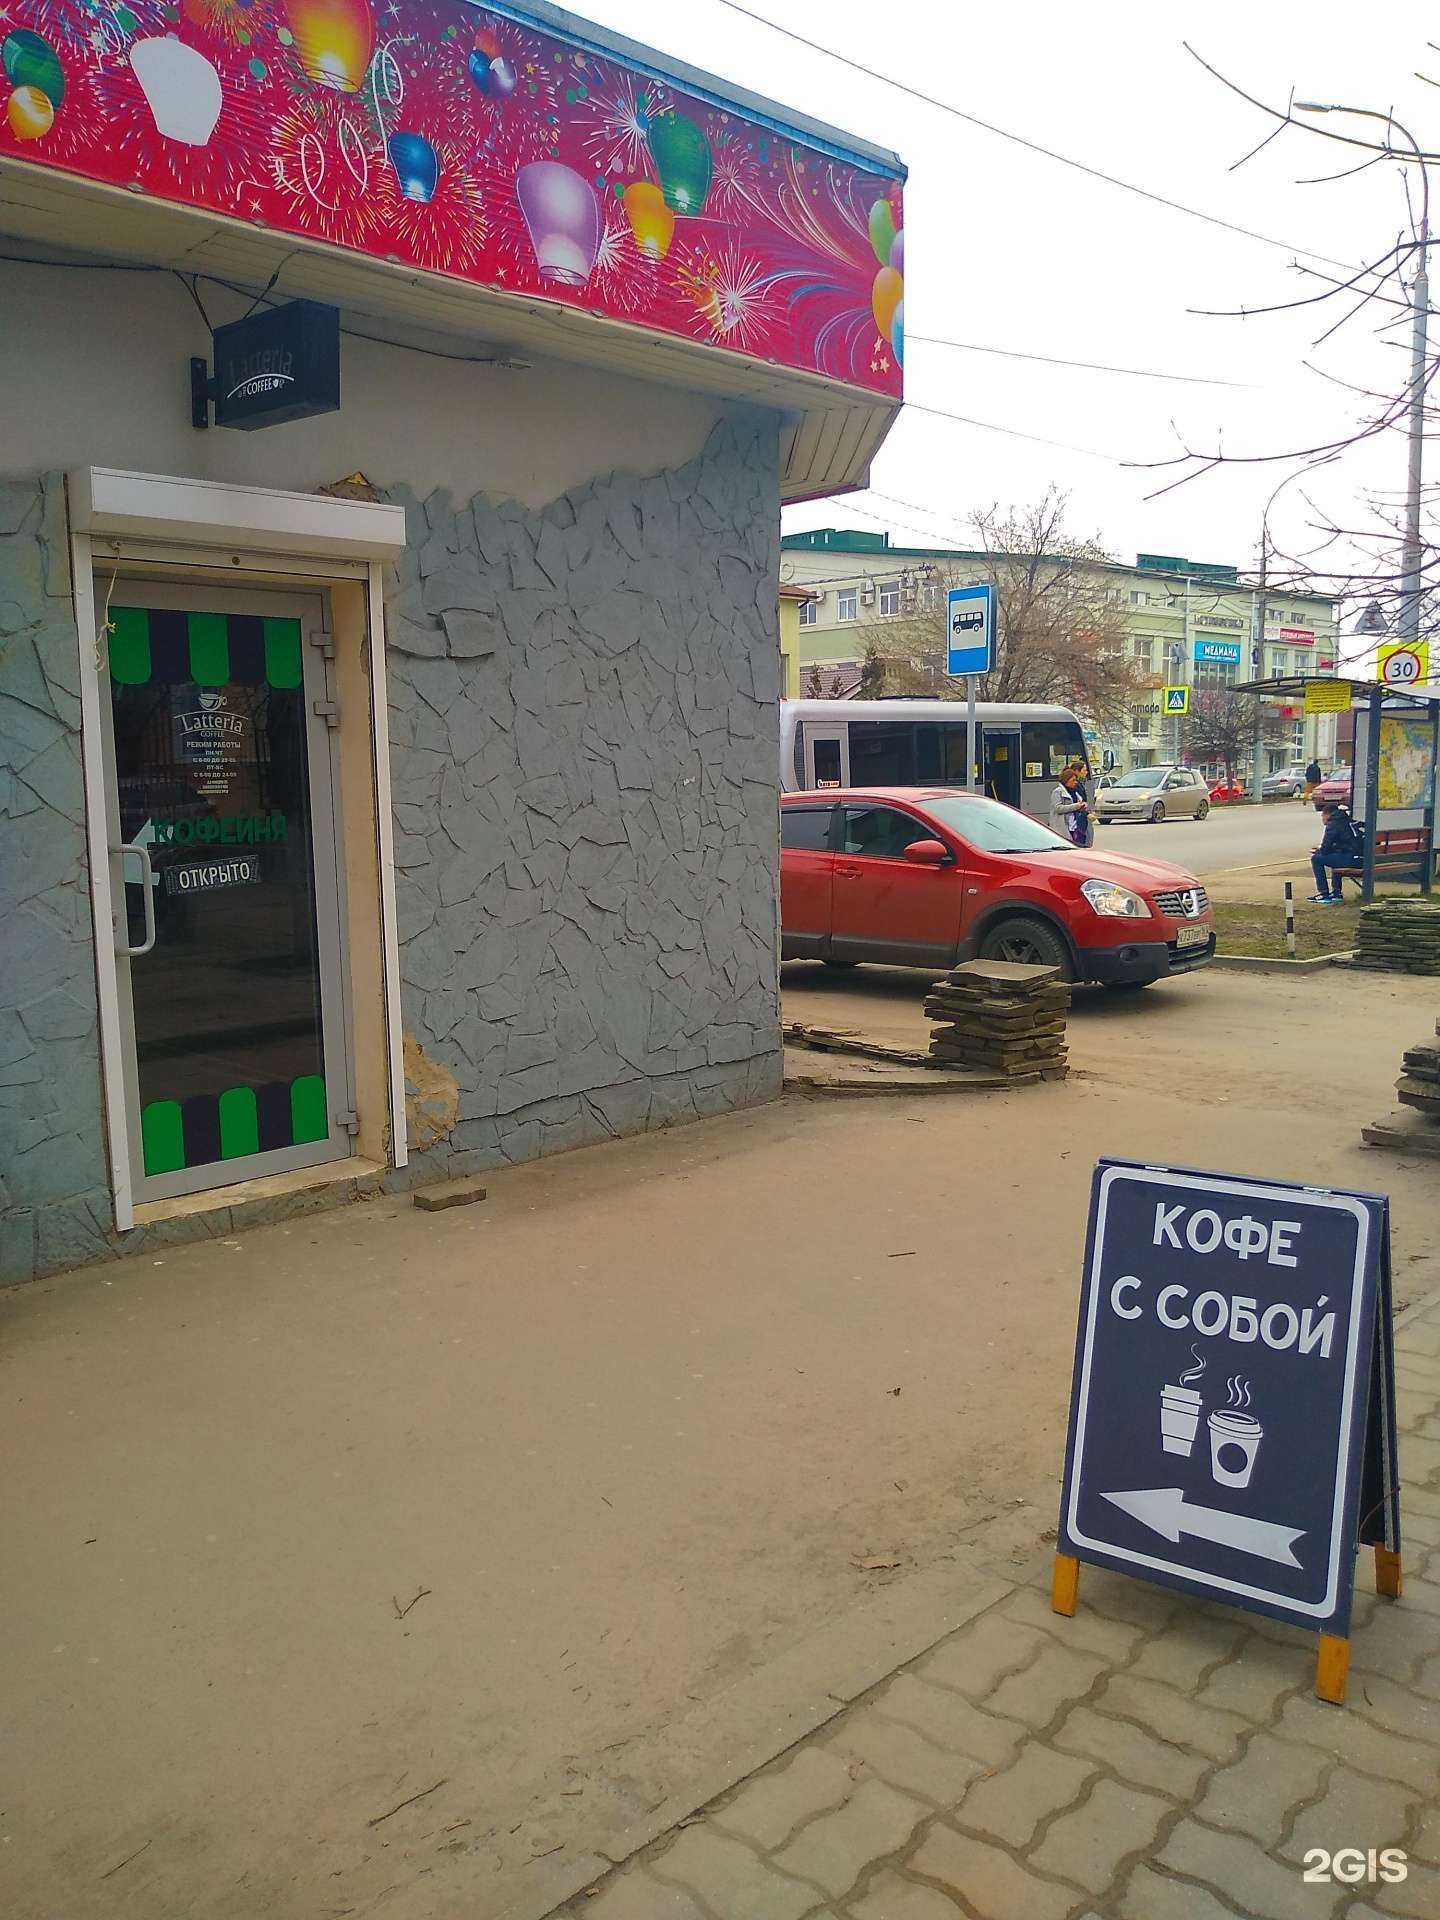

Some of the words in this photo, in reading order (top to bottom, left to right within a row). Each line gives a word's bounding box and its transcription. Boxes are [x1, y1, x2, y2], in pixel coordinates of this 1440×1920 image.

[246, 378, 272, 395] COFFEE
[1391, 661, 1413, 678] 30
[181, 713, 243, 733] Latteria
[179, 862, 250, 889] ОТКРЫТО
[1152, 1202, 1301, 1268] КОФЕ
[1110, 1275, 1143, 1320] С
[1156, 1284, 1336, 1358] СОБОЙ
